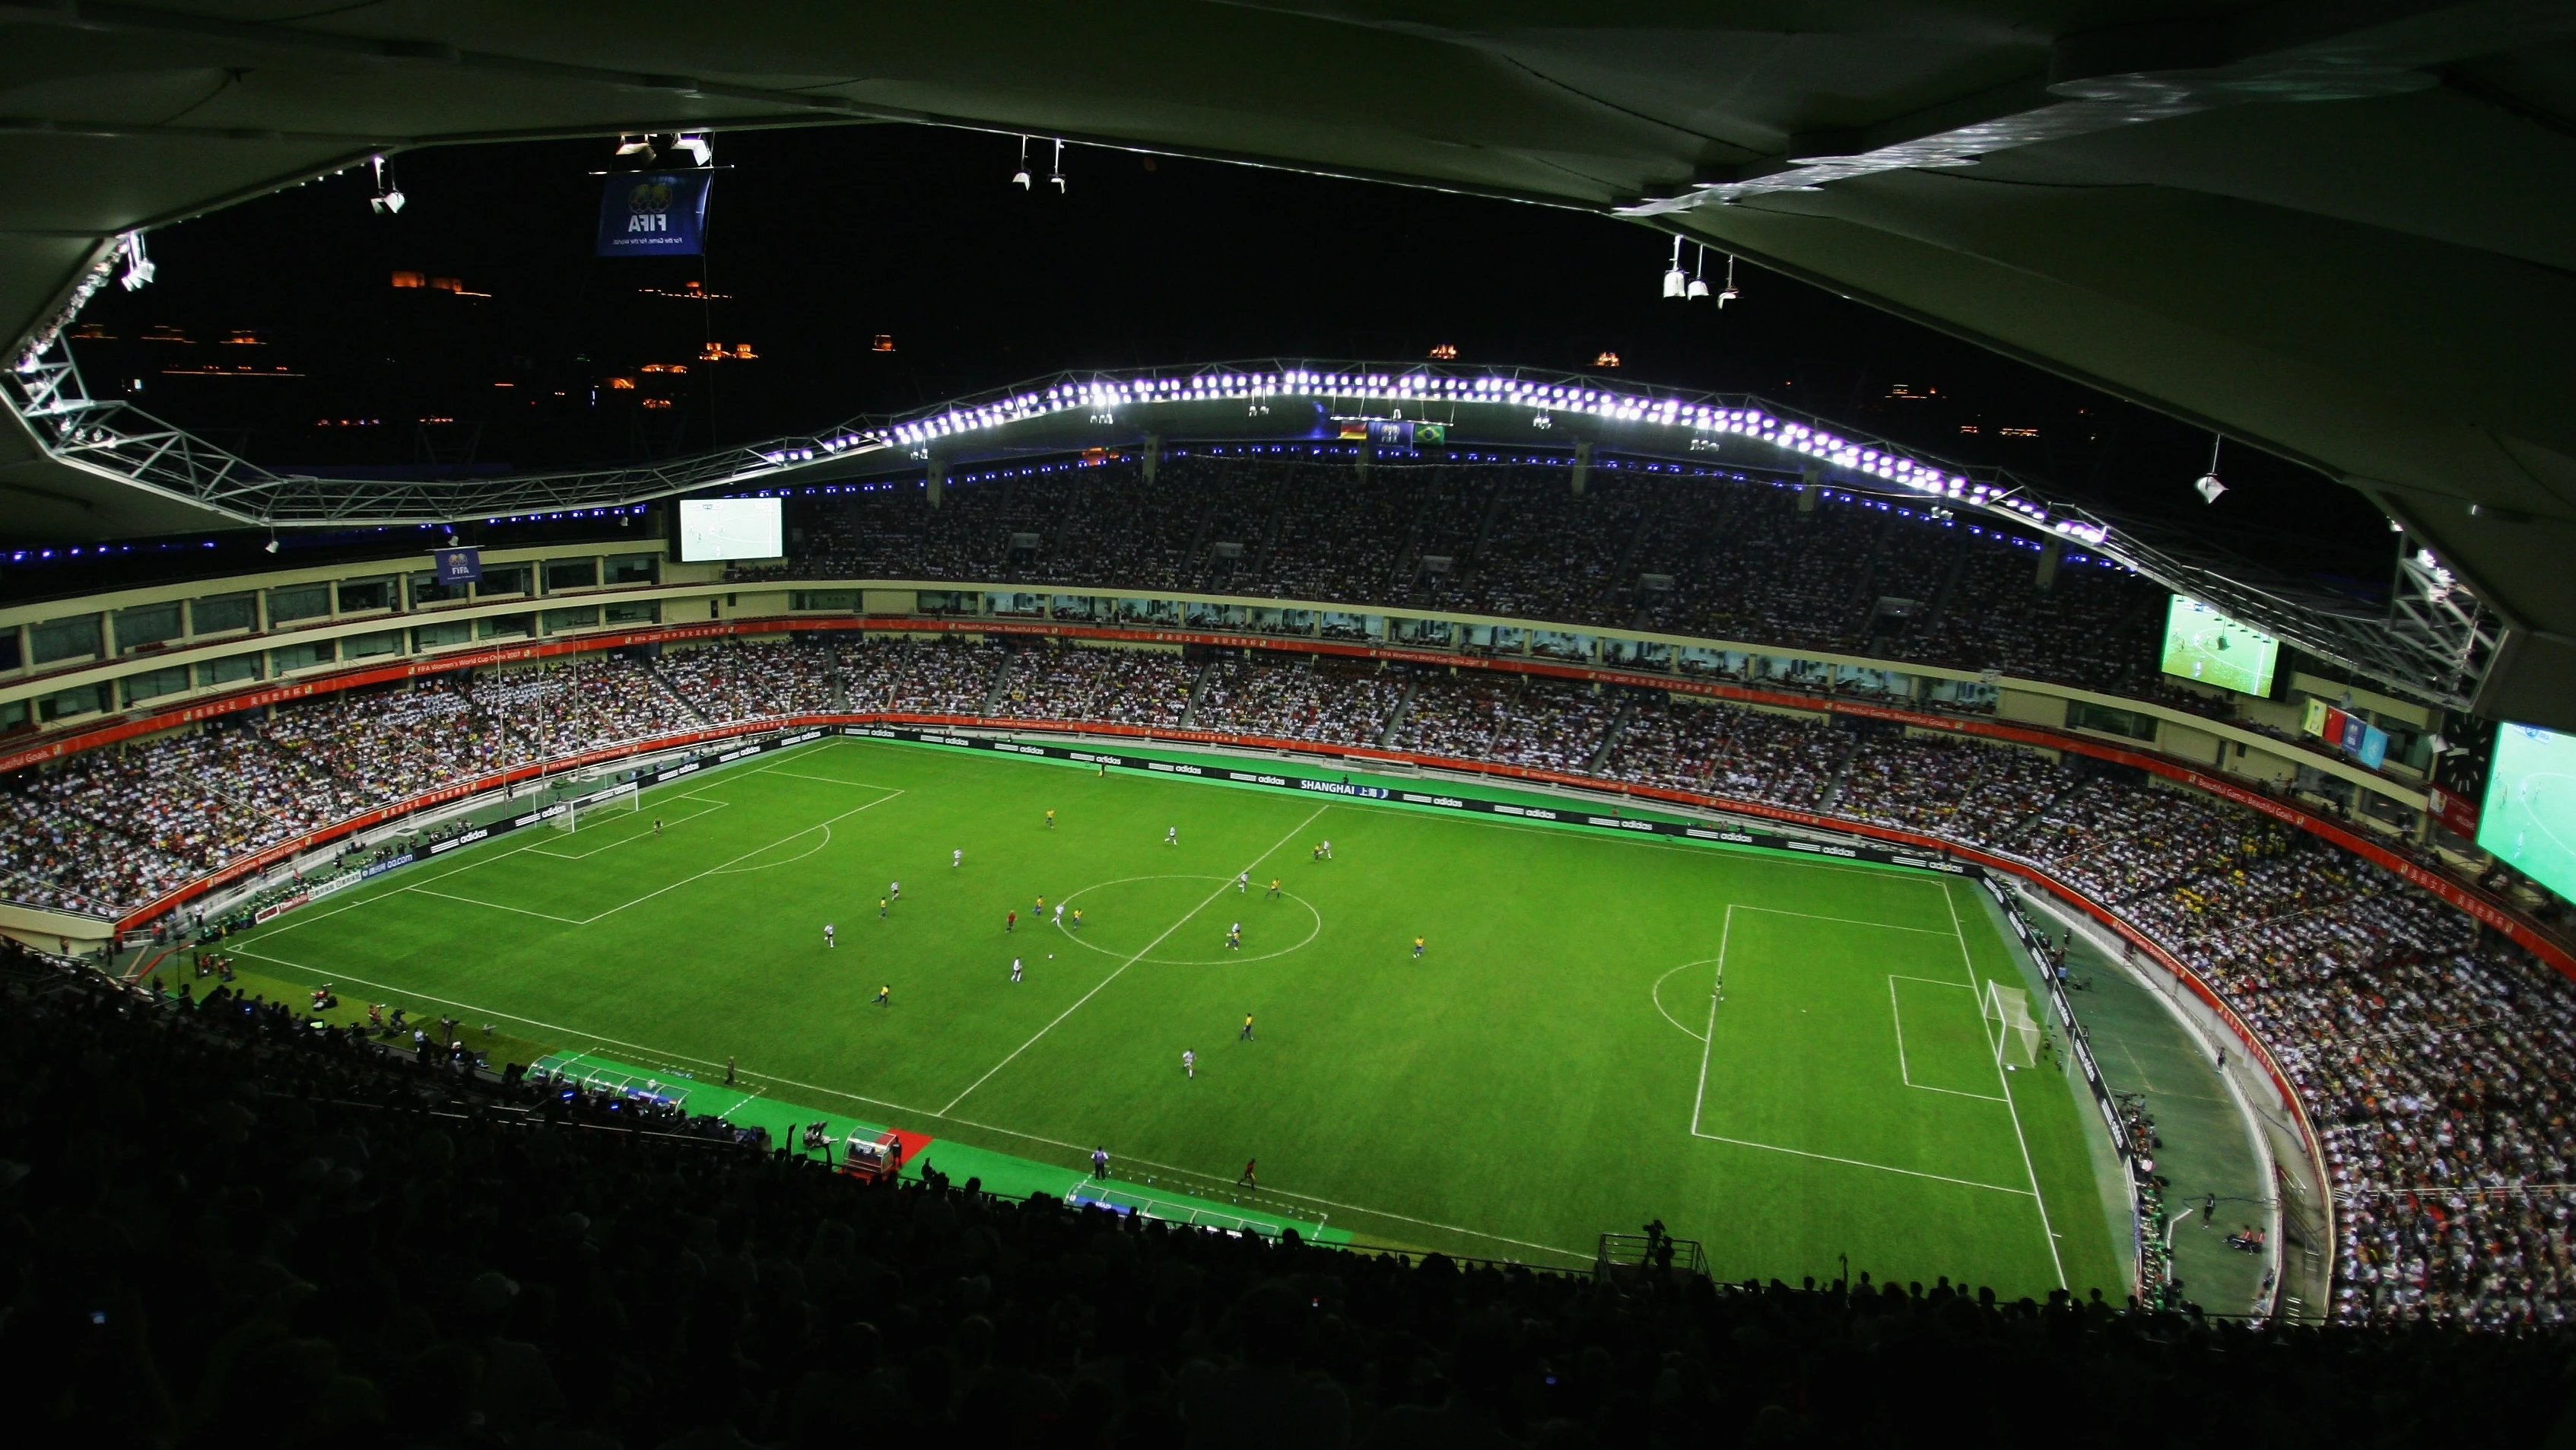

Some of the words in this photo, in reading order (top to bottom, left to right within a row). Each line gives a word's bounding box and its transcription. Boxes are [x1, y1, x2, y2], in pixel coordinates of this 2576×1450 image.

[452, 567, 469, 575] FIFA
[418, 664, 430, 673] FIFA
[432, 660, 458, 671] Women's
[459, 657, 476, 666] World
[490, 653, 506, 661] Chna
[801, 731, 821, 740] adidas
[945, 737, 969, 746] adidas
[740, 746, 761, 756] adidas
[1020, 746, 1043, 755] adidas
[1096, 755, 1121, 765] adidas
[679, 763, 699, 774] adidas
[1175, 765, 1201, 774] adidas
[1258, 776, 1285, 785] adidas
[1301, 779, 1355, 795] SHANGHAI
[1359, 787, 1377, 798] 上海
[2199, 778, 2226, 794] Beautiful
[2248, 797, 2275, 813] Beautiful
[1434, 797, 1463, 808] adidas
[542, 805, 567, 818] adidas
[1526, 809, 1556, 819] adidas
[1621, 820, 1653, 831] adidas
[460, 828, 488, 843] adidas
[1720, 832, 1752, 843] adidas
[1823, 846, 1856, 857] adidas
[387, 853, 413, 869] QQ.com
[1929, 861, 1963, 873] adidas
